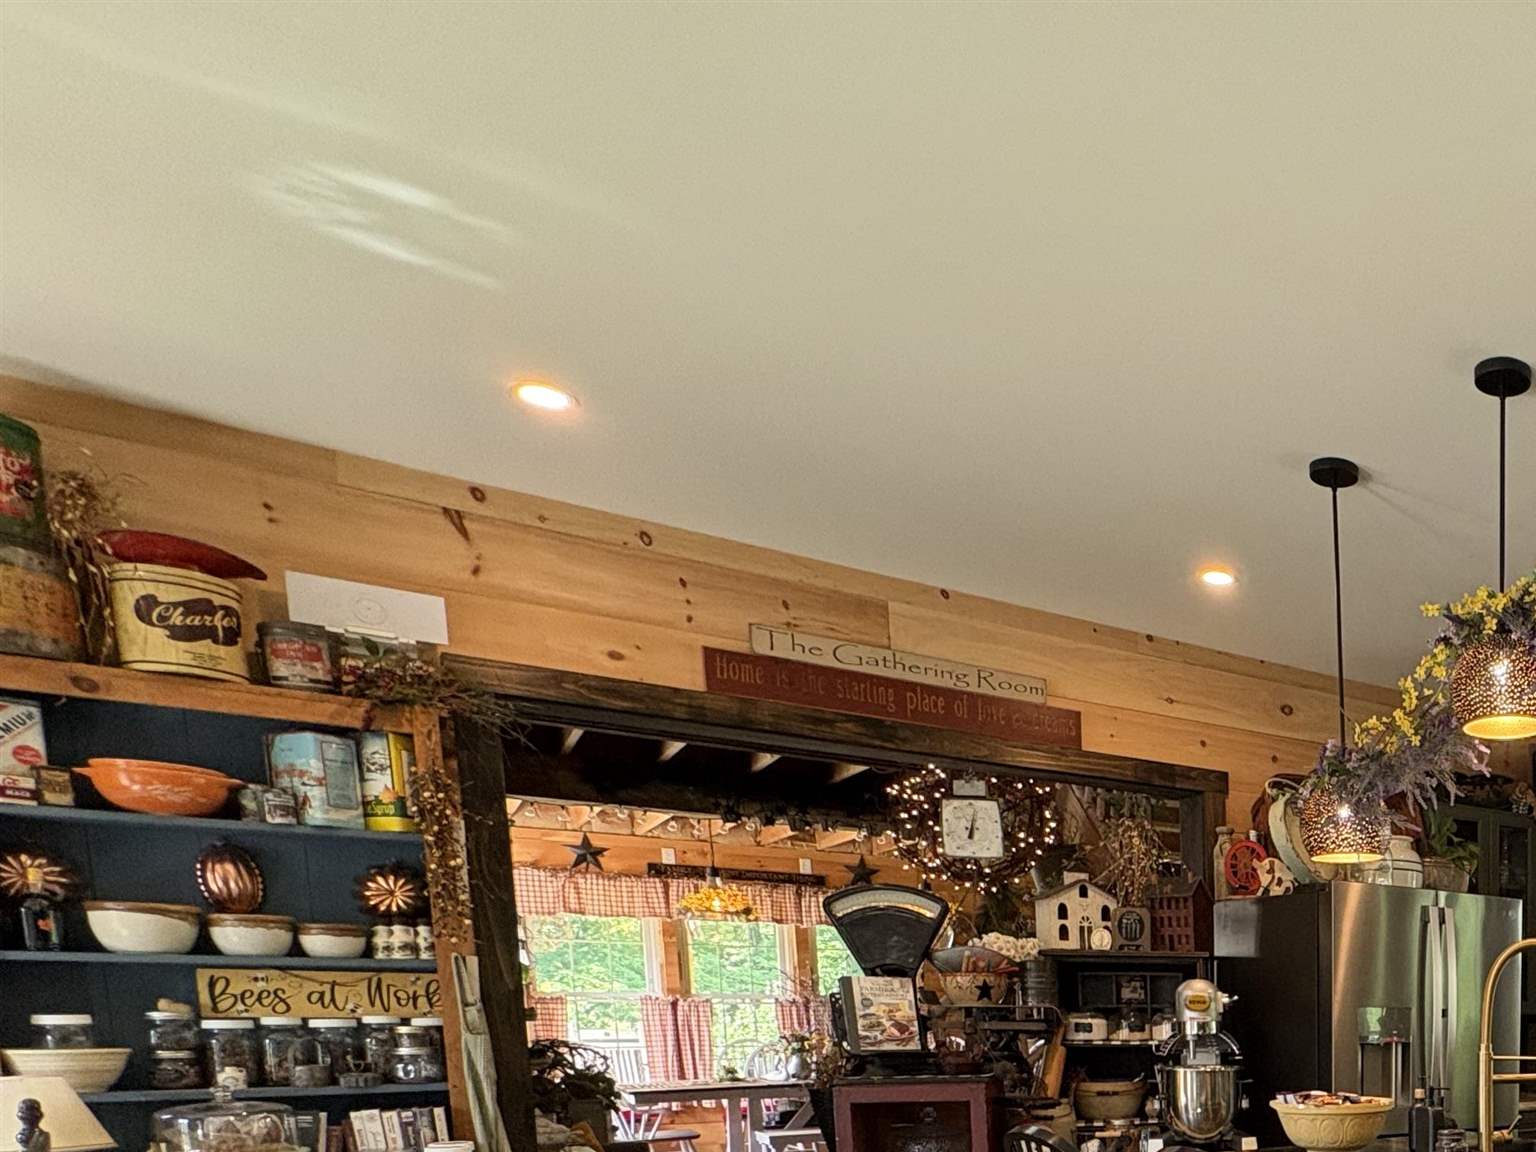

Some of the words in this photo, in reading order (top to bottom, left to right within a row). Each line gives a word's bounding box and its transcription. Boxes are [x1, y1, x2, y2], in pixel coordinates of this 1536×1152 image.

[715, 654, 764, 684] Home
[776, 663, 790, 689] is
[802, 669, 825, 695] the
[837, 676, 895, 713] starting
[906, 686, 945, 718] place
[954, 694, 968, 719] of
[978, 698, 1005, 725] love
[756, 626, 823, 657] The
[833, 643, 970, 689] Gathering
[977, 668, 1045, 697] Room
[0, 709, 35, 739] MIUM
[208, 974, 292, 1015] Bees
[307, 980, 348, 1012] at
[367, 977, 442, 1012] Work
